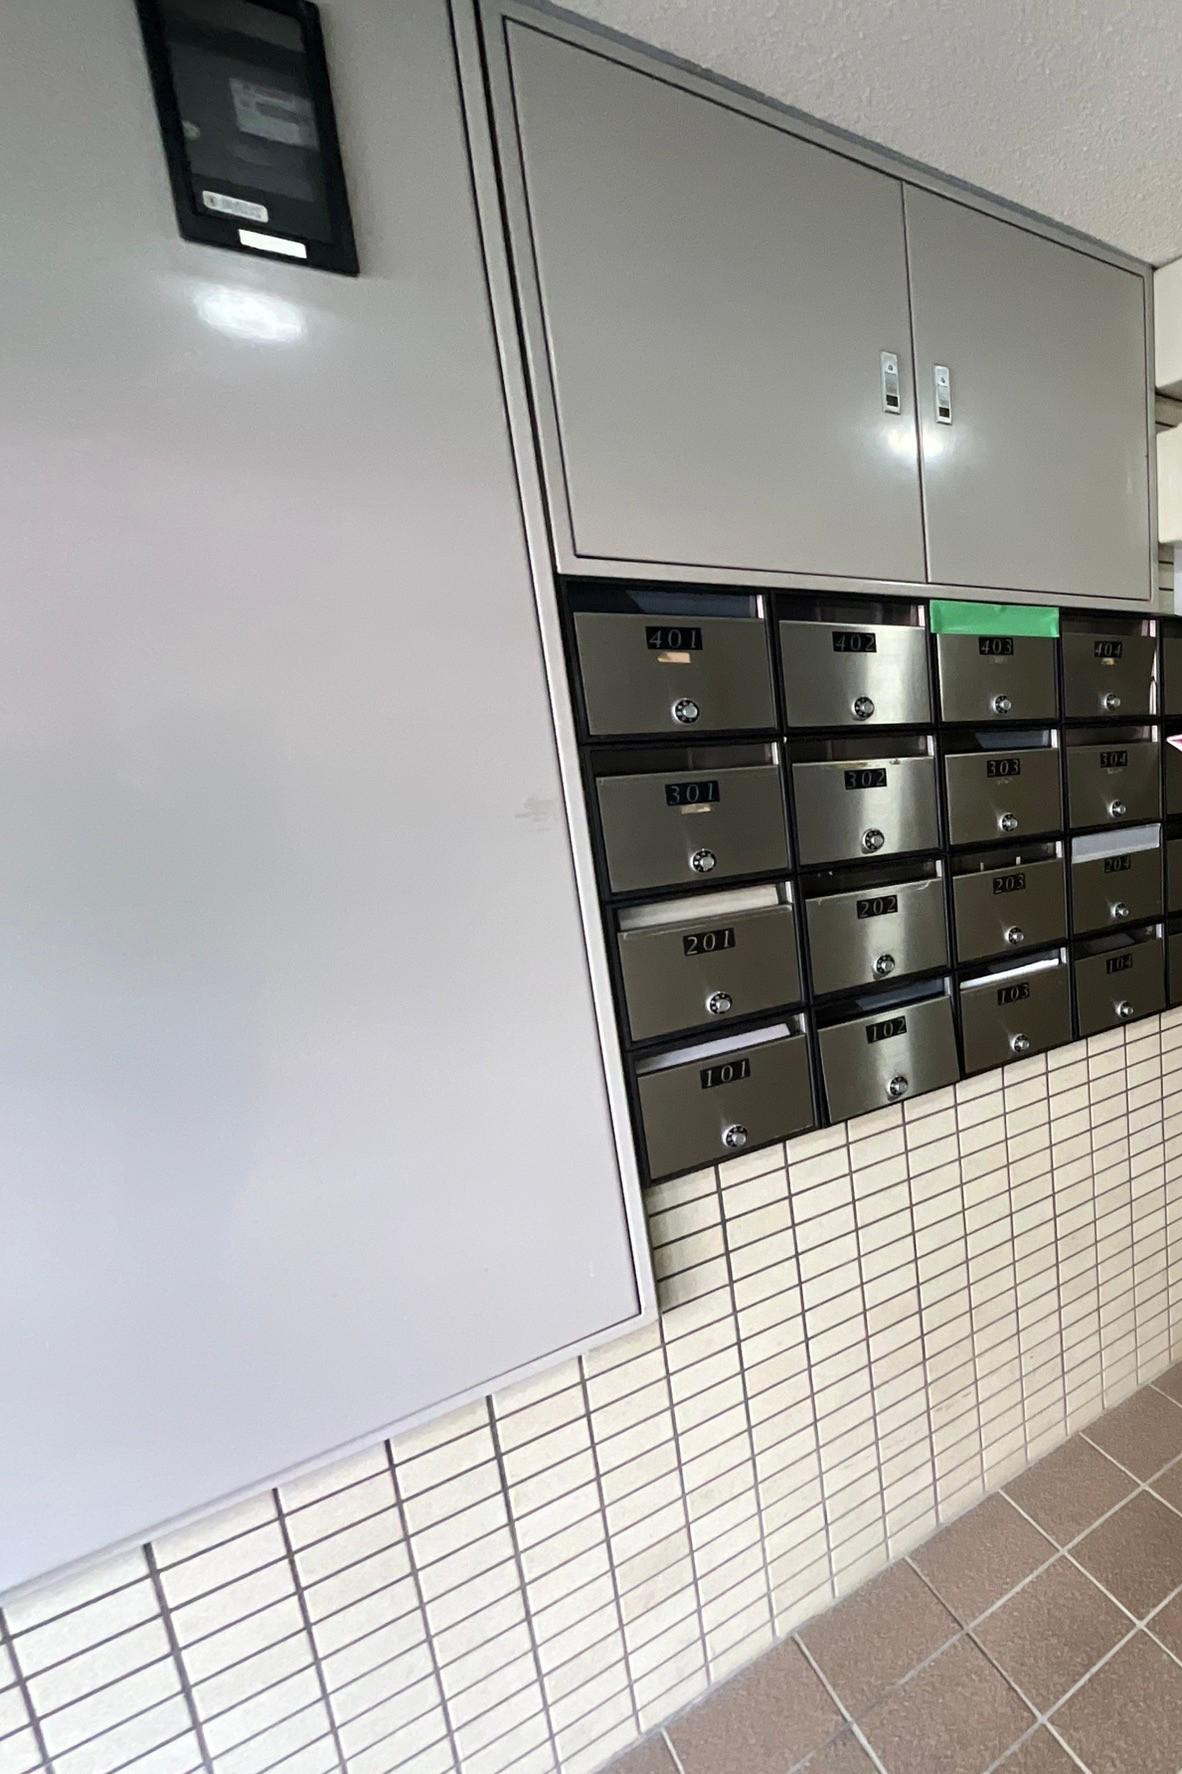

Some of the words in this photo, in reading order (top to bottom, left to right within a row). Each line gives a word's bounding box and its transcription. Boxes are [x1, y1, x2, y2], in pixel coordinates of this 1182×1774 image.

[648, 629, 697, 649] 401
[835, 634, 875, 651] 402
[981, 638, 1013, 654] 403
[1095, 642, 1121, 656] 404
[988, 760, 1019, 776] 303
[1101, 752, 1126, 766] 304
[848, 770, 885, 788] 302
[671, 784, 714, 804] 301
[995, 875, 1025, 892] 203
[860, 898, 897, 917] 202
[686, 931, 731, 955] 201
[1000, 985, 1029, 1003] 103
[871, 1019, 906, 1041] 102
[706, 1062, 749, 1086] 101
